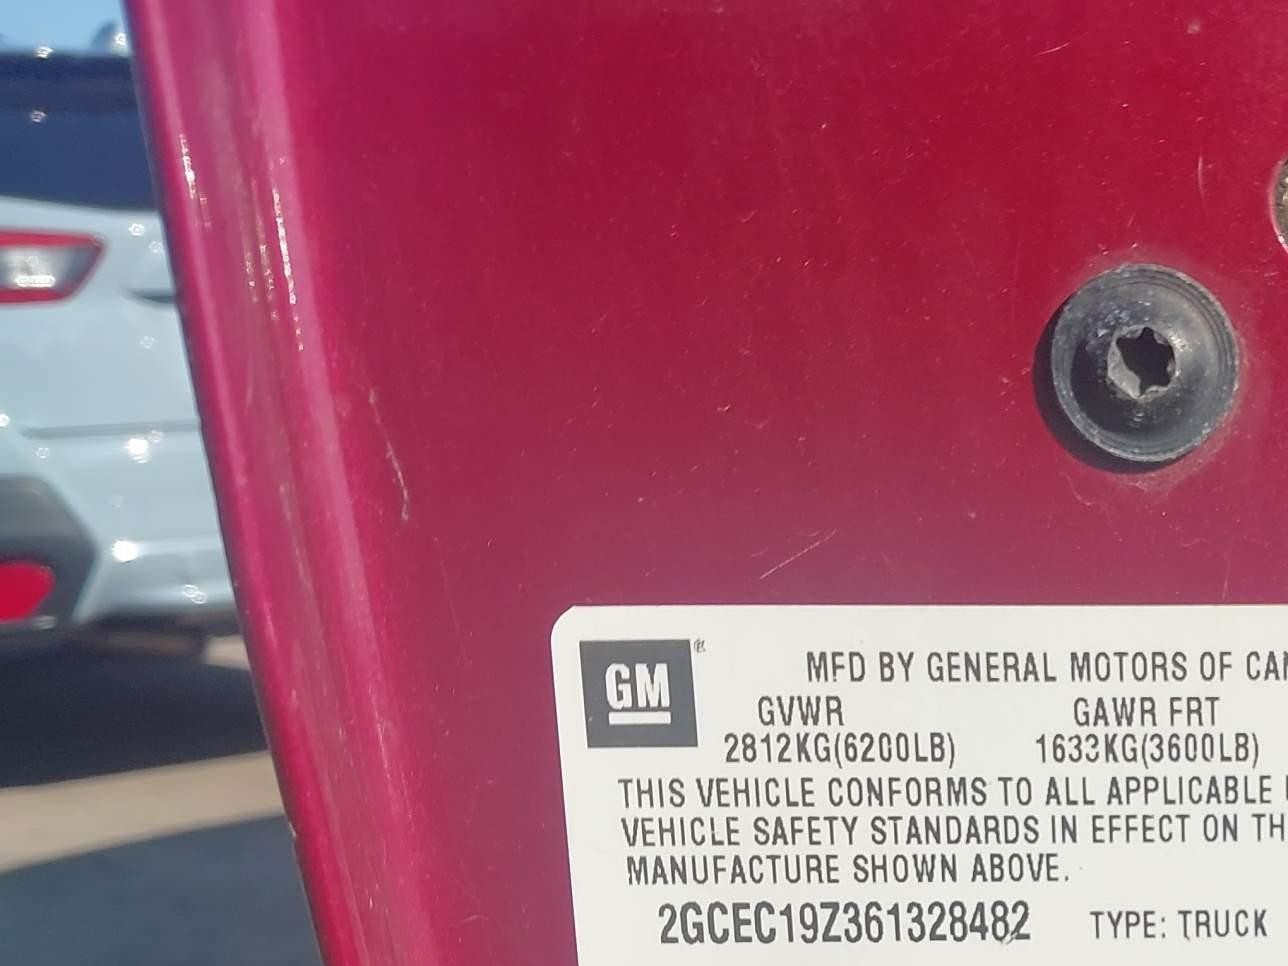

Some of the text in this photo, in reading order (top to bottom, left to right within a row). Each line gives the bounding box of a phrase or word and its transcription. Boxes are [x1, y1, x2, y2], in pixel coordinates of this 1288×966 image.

[807, 651, 865, 683] MFD
[879, 652, 914, 682] BY
[927, 651, 1057, 682] GENERAL
[1070, 651, 1187, 682] MOTORS
[1200, 651, 1232, 682] OF
[606, 663, 671, 709] GM
[758, 696, 844, 726] GVWR
[1074, 697, 1220, 727] GAWR FRT
[724, 732, 955, 769] 2812KG(6200LB)
[1036, 733, 1259, 770] 1633KG(3600LB)
[618, 778, 685, 808] THIS
[696, 777, 815, 808] VEHICLE
[828, 777, 987, 807] CONFORMS
[998, 777, 1032, 806] TO
[1045, 776, 1095, 806] ALL
[1107, 775, 1272, 806] APPLICABLE
[621, 816, 740, 847] VEHICLE
[753, 816, 858, 846] SAFETY
[870, 815, 1039, 845] STANDARDS
[1051, 815, 1077, 844] IN
[1092, 814, 1190, 843] EFFECT
[1203, 813, 1238, 842] ON
[627, 853, 1069, 885] MANUFACTURE SHOWN ABOVE.
[659, 900, 1031, 945] 2GCEC19Z361328482
[1089, 909, 1267, 940] TYPE: TRUCK
